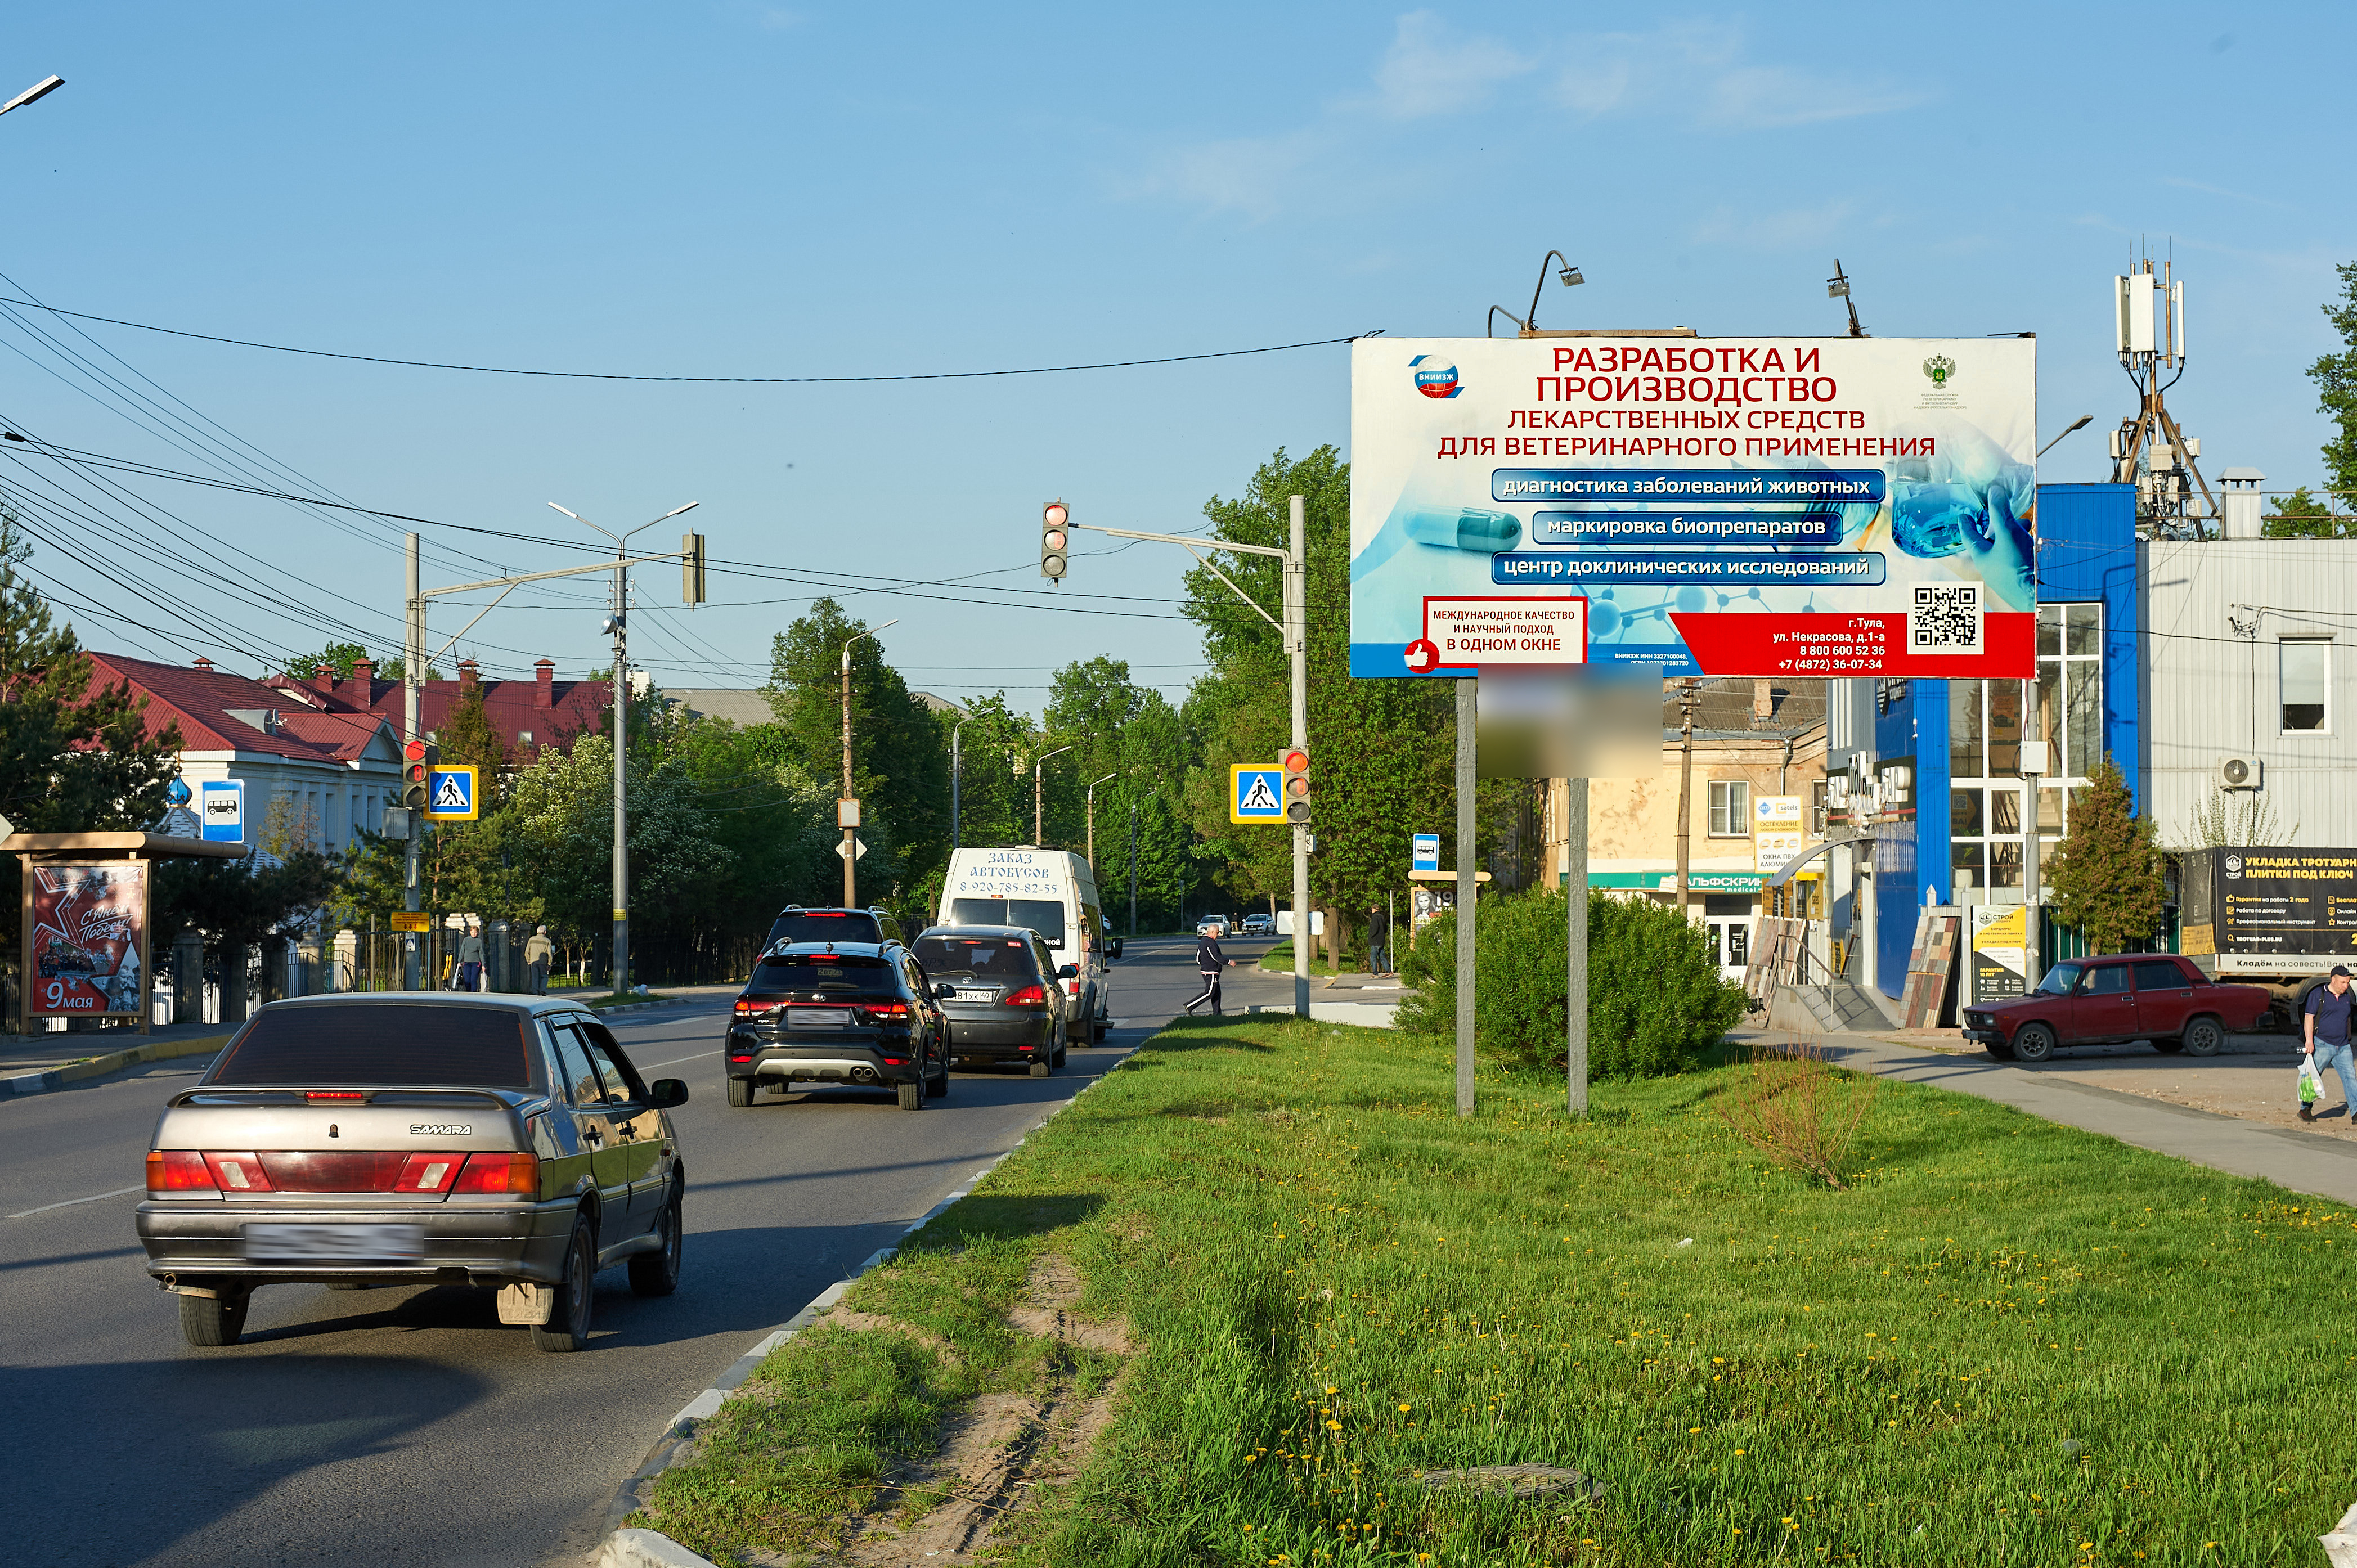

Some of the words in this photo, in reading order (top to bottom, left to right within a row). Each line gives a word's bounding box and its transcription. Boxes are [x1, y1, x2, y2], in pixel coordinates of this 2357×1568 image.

[1553, 347, 1785, 372] РАЗРАБОТКА
[1794, 347, 1820, 372] И
[1537, 376, 1837, 407] ПРОИЗВОДСТВО
[1508, 410, 1740, 429] ЛЕКАРСТВЕННЫХ
[1747, 411, 1865, 433] СРЕДСТВ
[1438, 437, 1496, 459] ДЛЯ
[1505, 437, 1737, 456] ВЕТЕРИНАРНОГО
[1745, 438, 1935, 456] ПРИМЕНЕНИЯ
[1503, 480, 1629, 496] диагностика
[1633, 477, 1763, 493] заболеваний
[1768, 481, 1870, 493] животных
[1548, 521, 1667, 537] маркировка
[1672, 517, 1826, 538] биопрепаратов
[1503, 561, 1563, 577] центр
[1568, 561, 1722, 577] доклинических
[1727, 558, 1869, 577] исследований
[1434, 610, 1523, 621] МЕЖДУНАРОДНОЕ
[1525, 611, 1575, 620] КАЧЕСТВО
[1454, 625, 1461, 634] И
[1463, 623, 1511, 634] НАУЧНЫЙ
[1514, 625, 1554, 635] ПОДХОД
[1848, 618, 1885, 630] г.Тула,
[1773, 634, 1789, 644] ул.
[1792, 632, 1855, 644] Некрасова,
[1857, 632, 1885, 643] д.1-а
[1447, 639, 1456, 650] В
[1460, 639, 1516, 653] ОДНОМ
[1521, 639, 1561, 650] ОКНЕ
[1800, 646, 1807, 655] 8
[1810, 646, 1830, 655] 800
[1832, 646, 1853, 655] 600
[1855, 646, 1869, 655] 52
[1871, 646, 1885, 655] 36
[1779, 659, 1793, 669] +7
[1795, 659, 1830, 671] (4872)
[1833, 659, 1883, 669] 36-07-34
[988, 853, 1032, 864] ЗАКАЗ
[2245, 857, 2300, 868] УКЛАДКА
[970, 866, 1049, 880] АВТОБУСОВ
[2246, 869, 2291, 879] ПЛИТКИ
[2293, 870, 2318, 880] ПОД
[2319, 870, 2354, 879] КЛЮЧ
[960, 882, 1057, 894] 8-920-785-82-55
[46, 982, 64, 1008] 9
[63, 997, 93, 1008] мая
[410, 1124, 472, 1135] SAMARA
